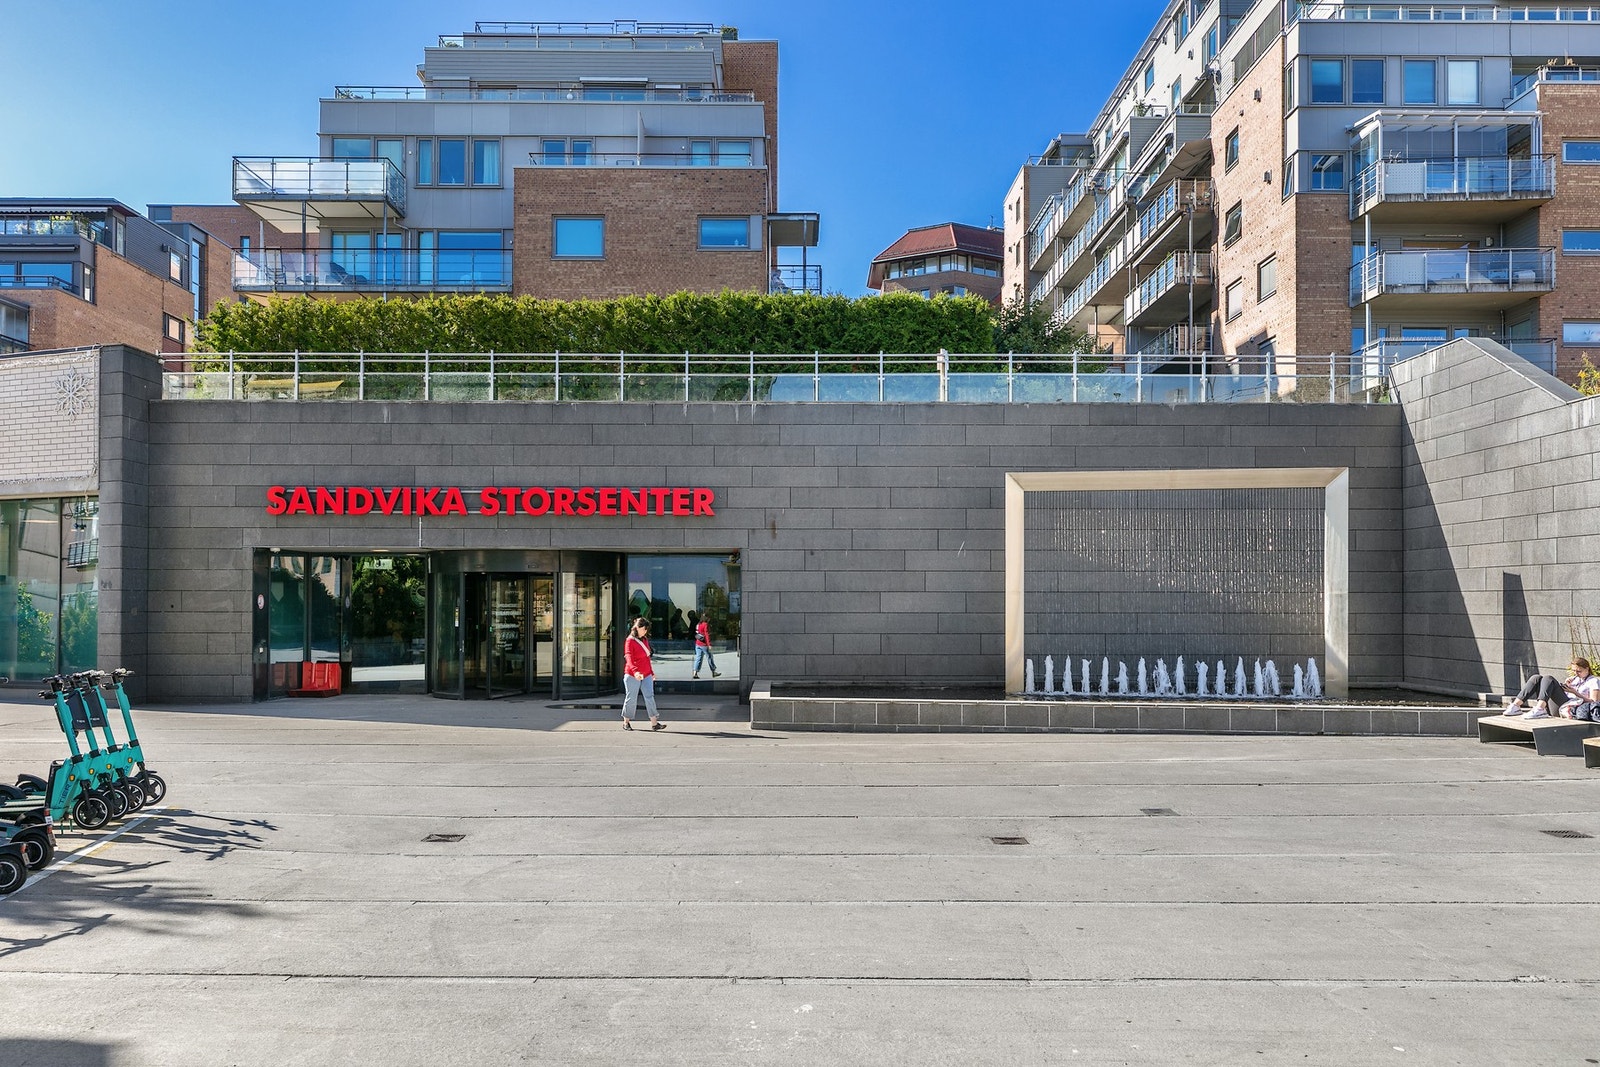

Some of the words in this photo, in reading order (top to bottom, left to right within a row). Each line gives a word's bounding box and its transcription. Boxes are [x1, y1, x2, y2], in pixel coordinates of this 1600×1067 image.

[266, 485, 468, 516] SANDVIKA
[479, 486, 715, 517] STORSENTER
[58, 783, 72, 804] TIER
